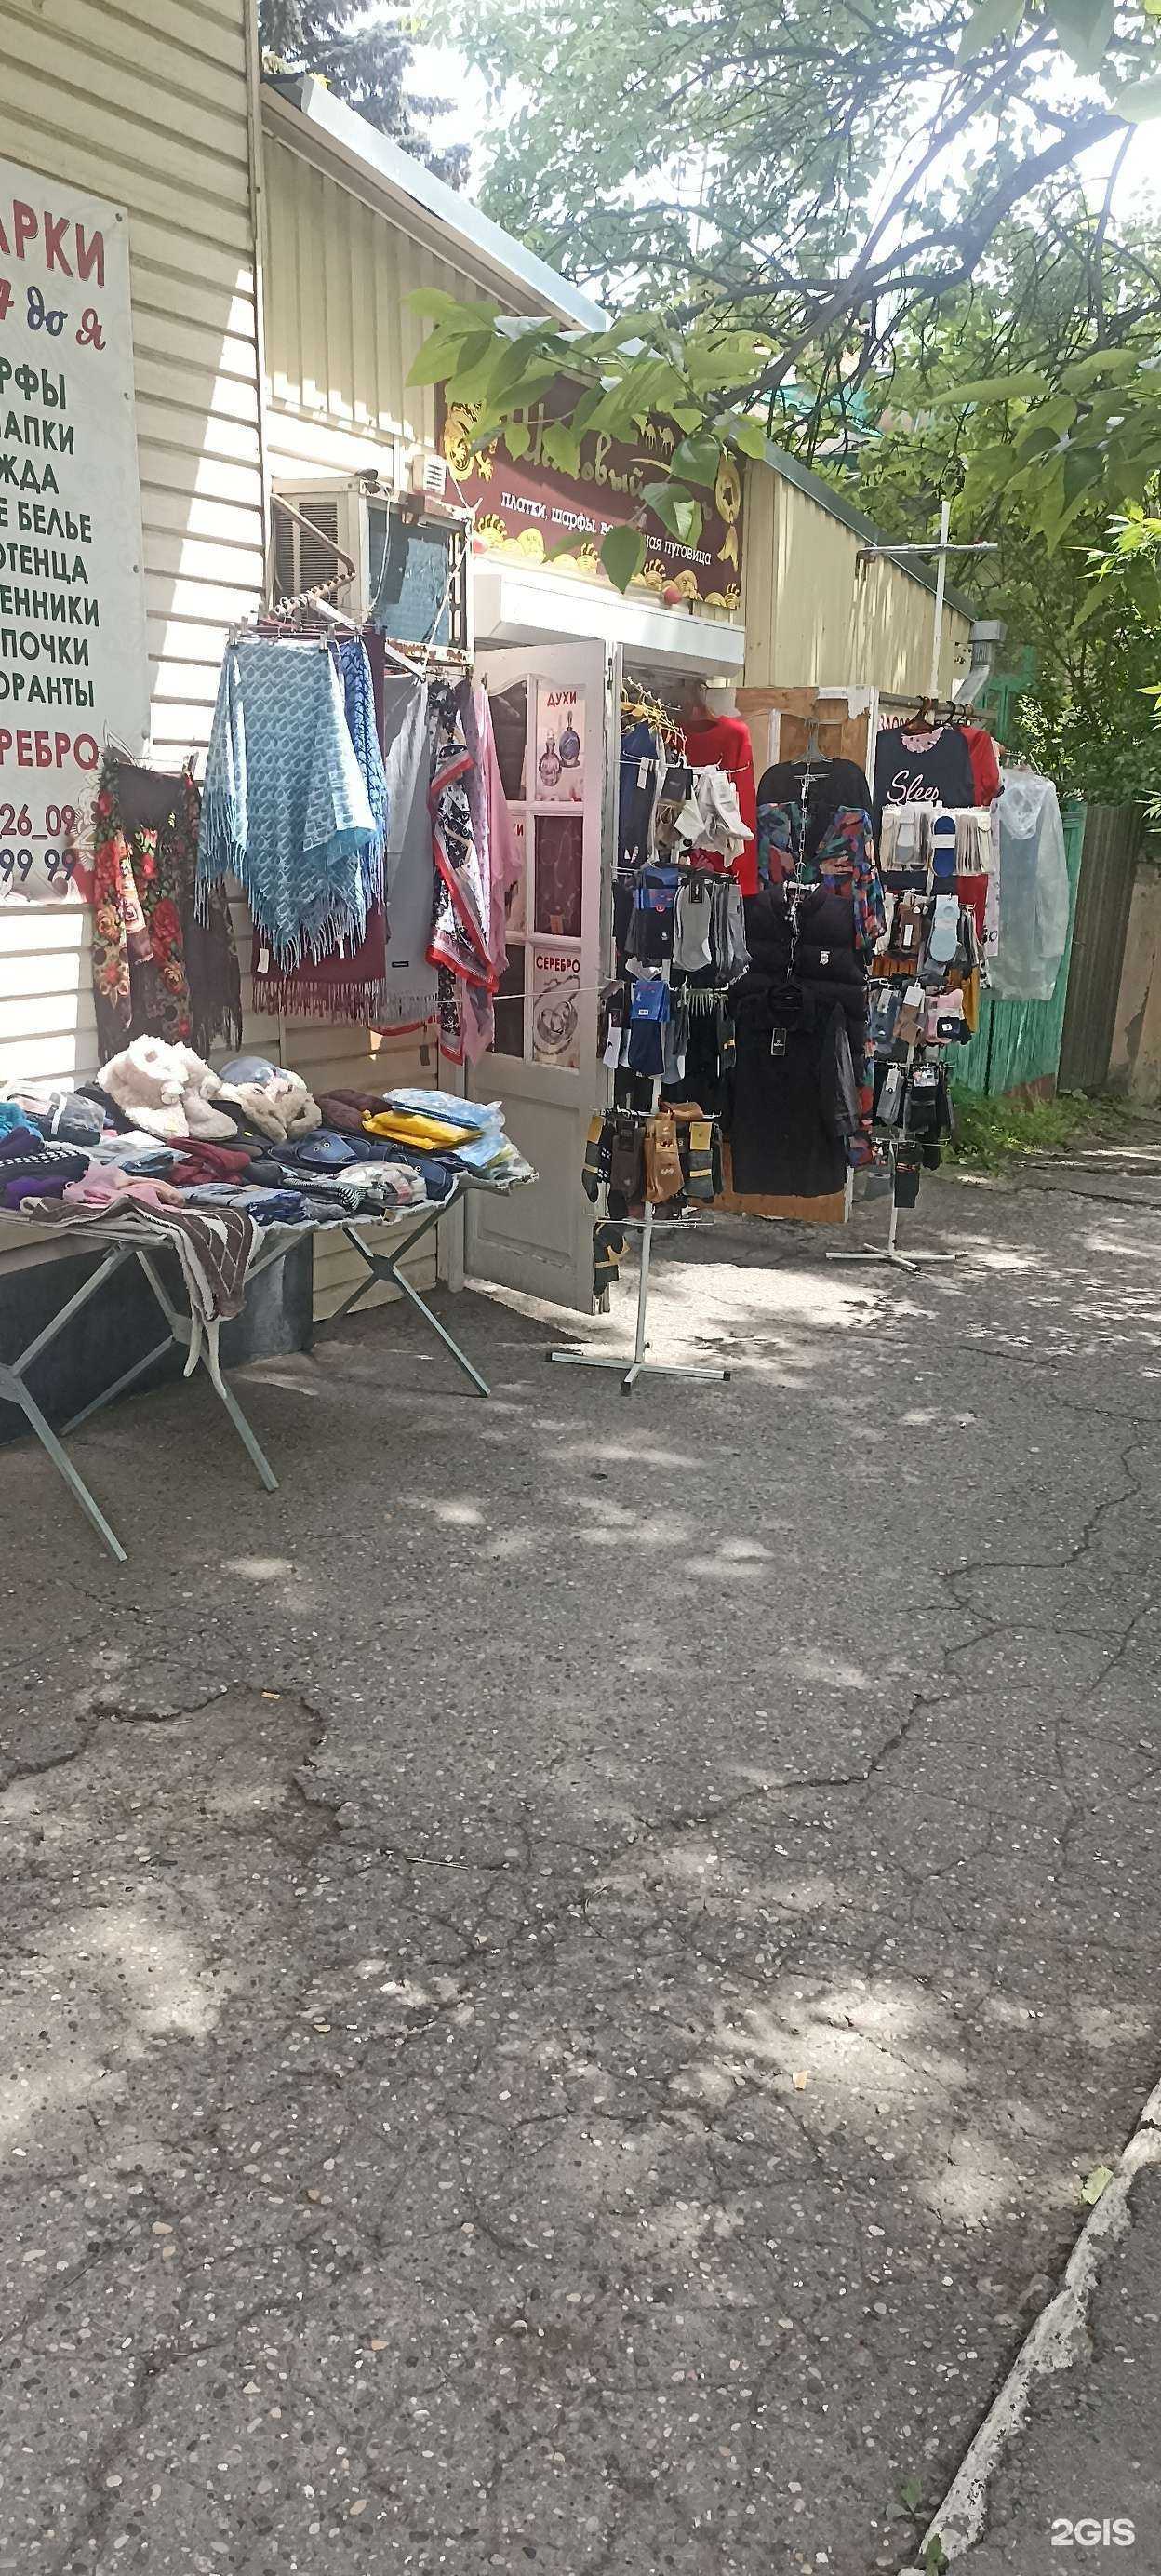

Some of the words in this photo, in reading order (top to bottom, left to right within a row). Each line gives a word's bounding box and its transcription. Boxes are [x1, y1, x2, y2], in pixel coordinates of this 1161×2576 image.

[27, 286, 68, 337] до
[0, 410, 74, 455] АПКИ
[18, 501, 91, 543] БЕЛЬЕ
[663, 541, 712, 565] пуговица
[0, 584, 100, 627] ЕННИКИ
[1, 627, 89, 667] ПОЧКИ
[546, 691, 577, 707] ДУХИ
[536, 955, 580, 974] СЕРЕБРО
